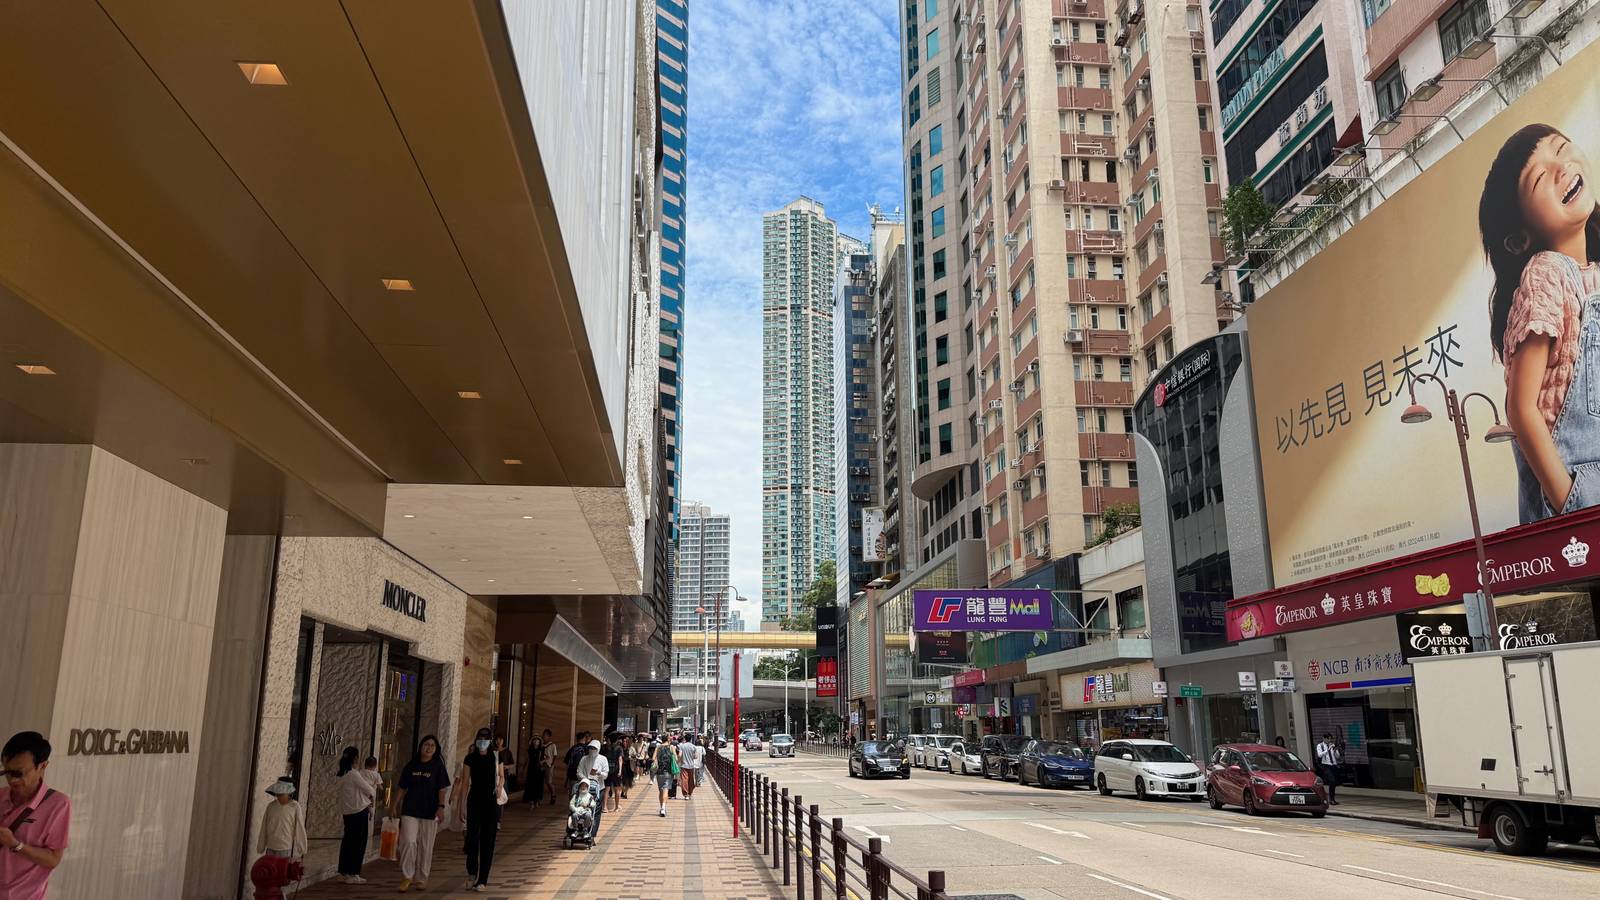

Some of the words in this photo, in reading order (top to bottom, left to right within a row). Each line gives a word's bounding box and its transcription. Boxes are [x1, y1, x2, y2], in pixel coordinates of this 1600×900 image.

[1253, 44, 1285, 93] PLAZA
[1276, 399, 1351, 453] 以先見
[1363, 324, 1464, 415] 見未來
[383, 579, 426, 622] MONCLER
[966, 597, 1007, 616] 龍豐
[1009, 598, 1041, 616] Mall
[1340, 586, 1393, 613] 英皇珠寶
[1275, 605, 1318, 626] EMPEROR
[1409, 624, 1470, 651] EMPEROR
[1500, 623, 1558, 651] EMPEROR
[1323, 660, 1349, 676] NCB
[67, 728, 189, 756] DOLCE&GABBANA
